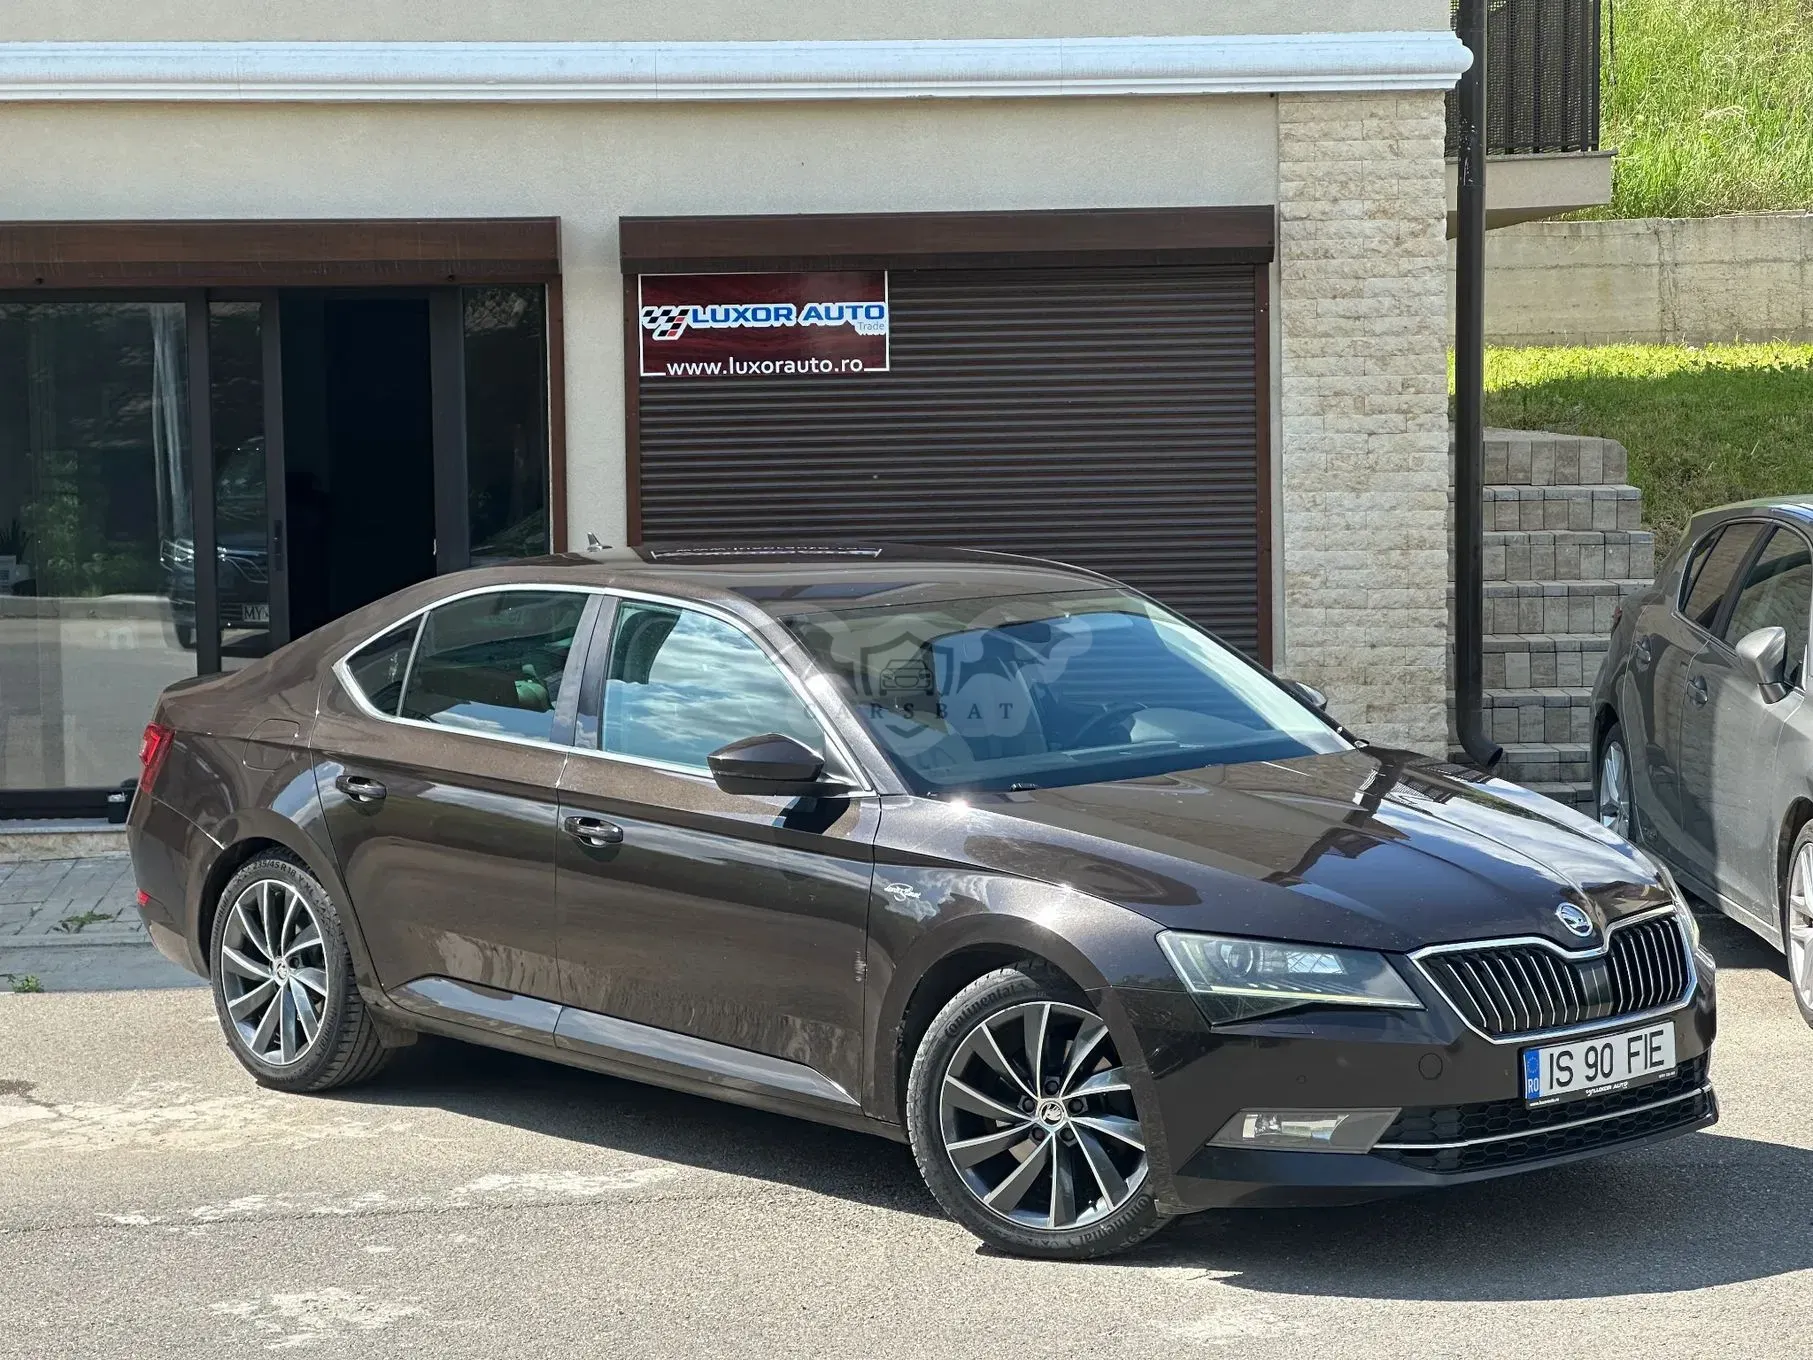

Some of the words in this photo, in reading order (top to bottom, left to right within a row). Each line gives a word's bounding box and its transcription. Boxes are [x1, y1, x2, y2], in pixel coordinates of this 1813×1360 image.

[692, 306, 793, 323] LUXOR
[802, 304, 885, 321] AUTO
[858, 321, 885, 331] Trade
[667, 356, 863, 376] www.luxorauto.ro
[1549, 1050, 1574, 1089] IS
[1584, 1042, 1614, 1082] 90
[1627, 1029, 1664, 1074] FIE
[1528, 1077, 1540, 1093] RO
